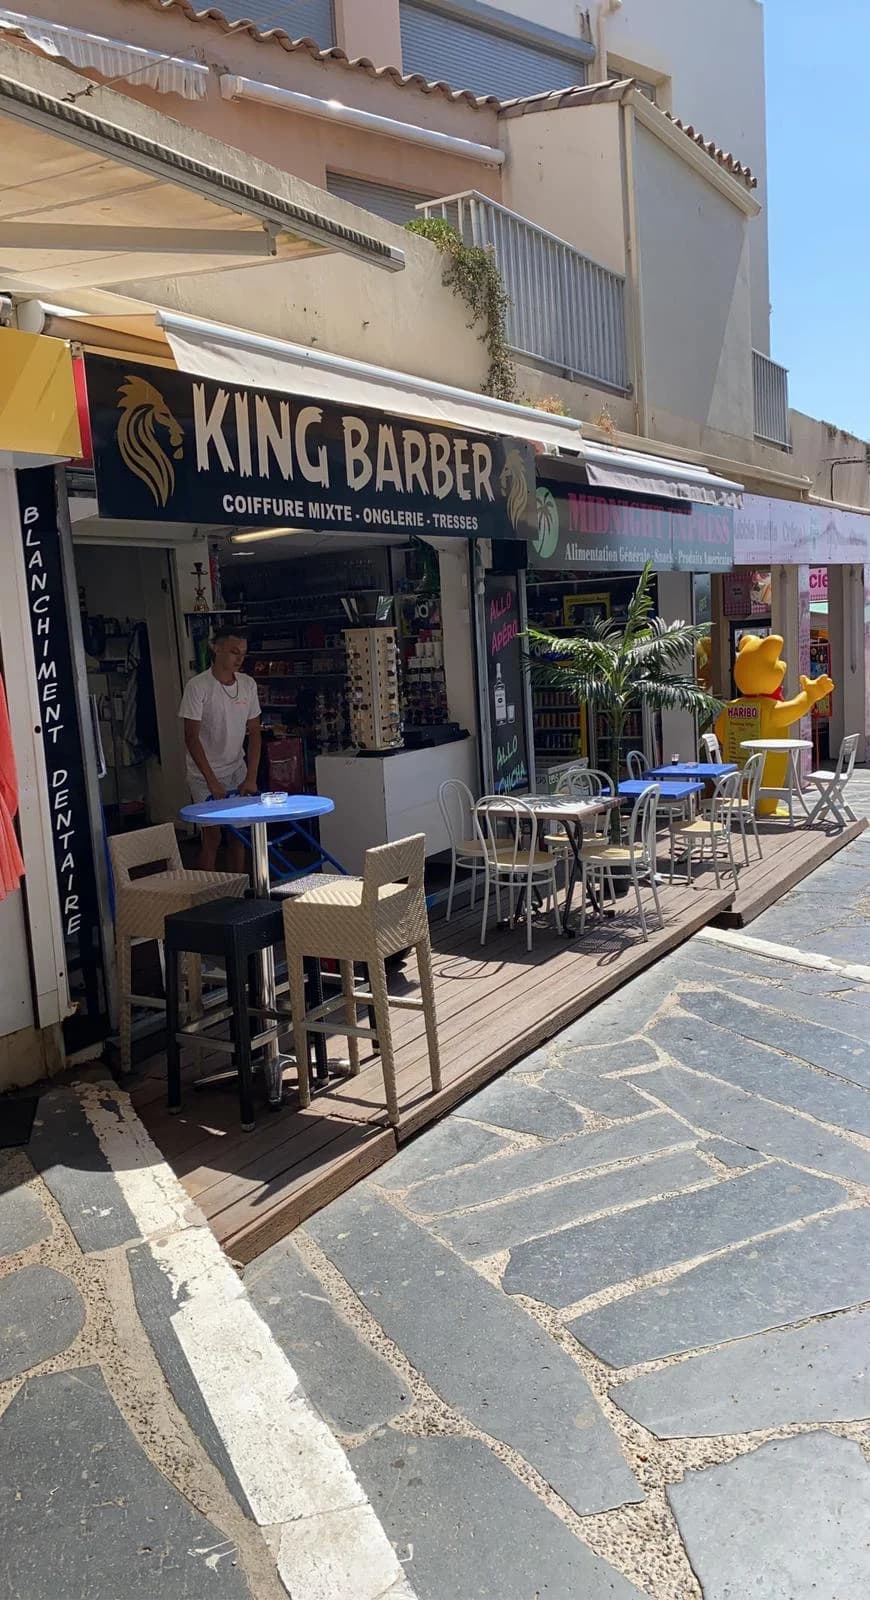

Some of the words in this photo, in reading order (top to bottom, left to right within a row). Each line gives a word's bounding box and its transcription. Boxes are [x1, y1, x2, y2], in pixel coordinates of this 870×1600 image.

[192, 382, 330, 489] KING
[340, 416, 496, 502] BARBER
[222, 494, 305, 518] COIFFURE
[308, 502, 353, 522] MIXTE
[363, 507, 425, 528] ONGLERIE
[433, 513, 479, 531] TRESSES
[568, 493, 663, 539] MIDNIGHT
[669, 505, 729, 545] EXPRESS
[565, 543, 618, 561] Alimentation
[490, 591, 512, 624] ALLO
[23, 506, 63, 745] BLANCHIMENT
[53, 769, 82, 936] DENTAIRE
[727, 706, 758, 717] HARIBO
[497, 735, 517, 771] ALLO
[498, 760, 527, 796] CHICHA
